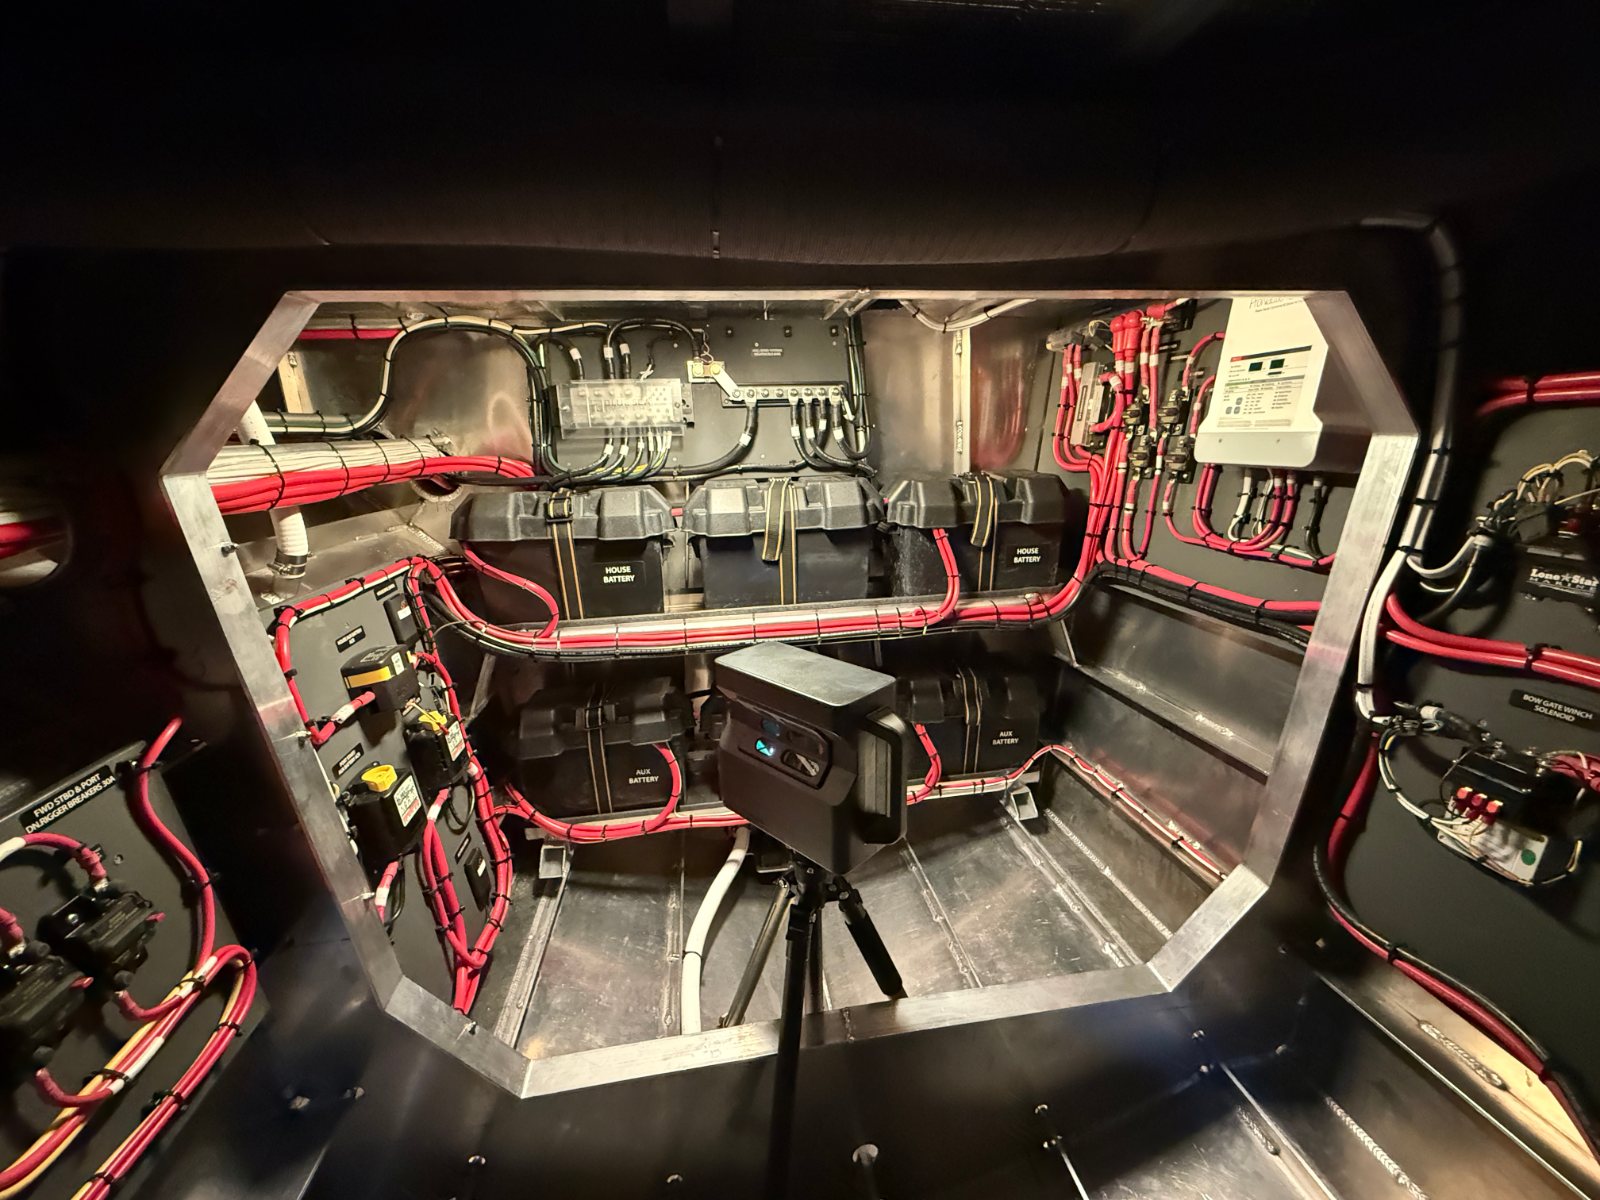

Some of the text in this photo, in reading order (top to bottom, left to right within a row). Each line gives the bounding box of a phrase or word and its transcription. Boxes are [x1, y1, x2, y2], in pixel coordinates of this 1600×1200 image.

[603, 575, 635, 583] BATTERY
[605, 566, 631, 574] HOUSE
[1530, 568, 1599, 587] Lone Star
[1523, 694, 1593, 719] BOW GATE WINCH
[1534, 705, 1575, 722] SOLENOID
[629, 776, 659, 784] BATTERY
[33, 773, 101, 818] FWD STBD & PORT
[67, 783, 103, 809] BREAKERS
